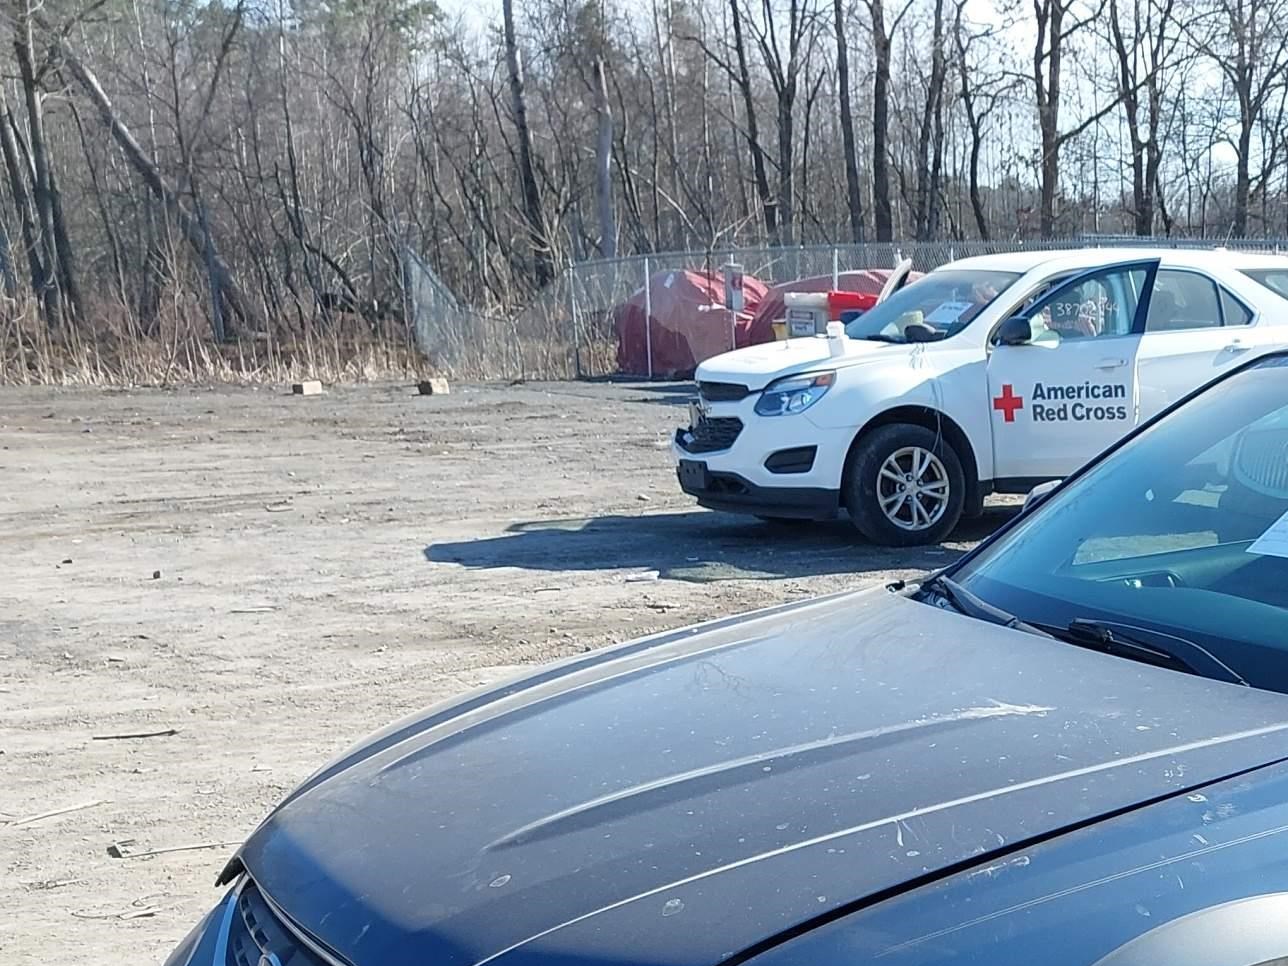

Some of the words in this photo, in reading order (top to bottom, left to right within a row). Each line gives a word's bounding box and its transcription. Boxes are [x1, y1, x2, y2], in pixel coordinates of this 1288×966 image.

[1032, 381, 1125, 400] American
[1032, 404, 1068, 421] Red
[1072, 403, 1126, 421] Cross
